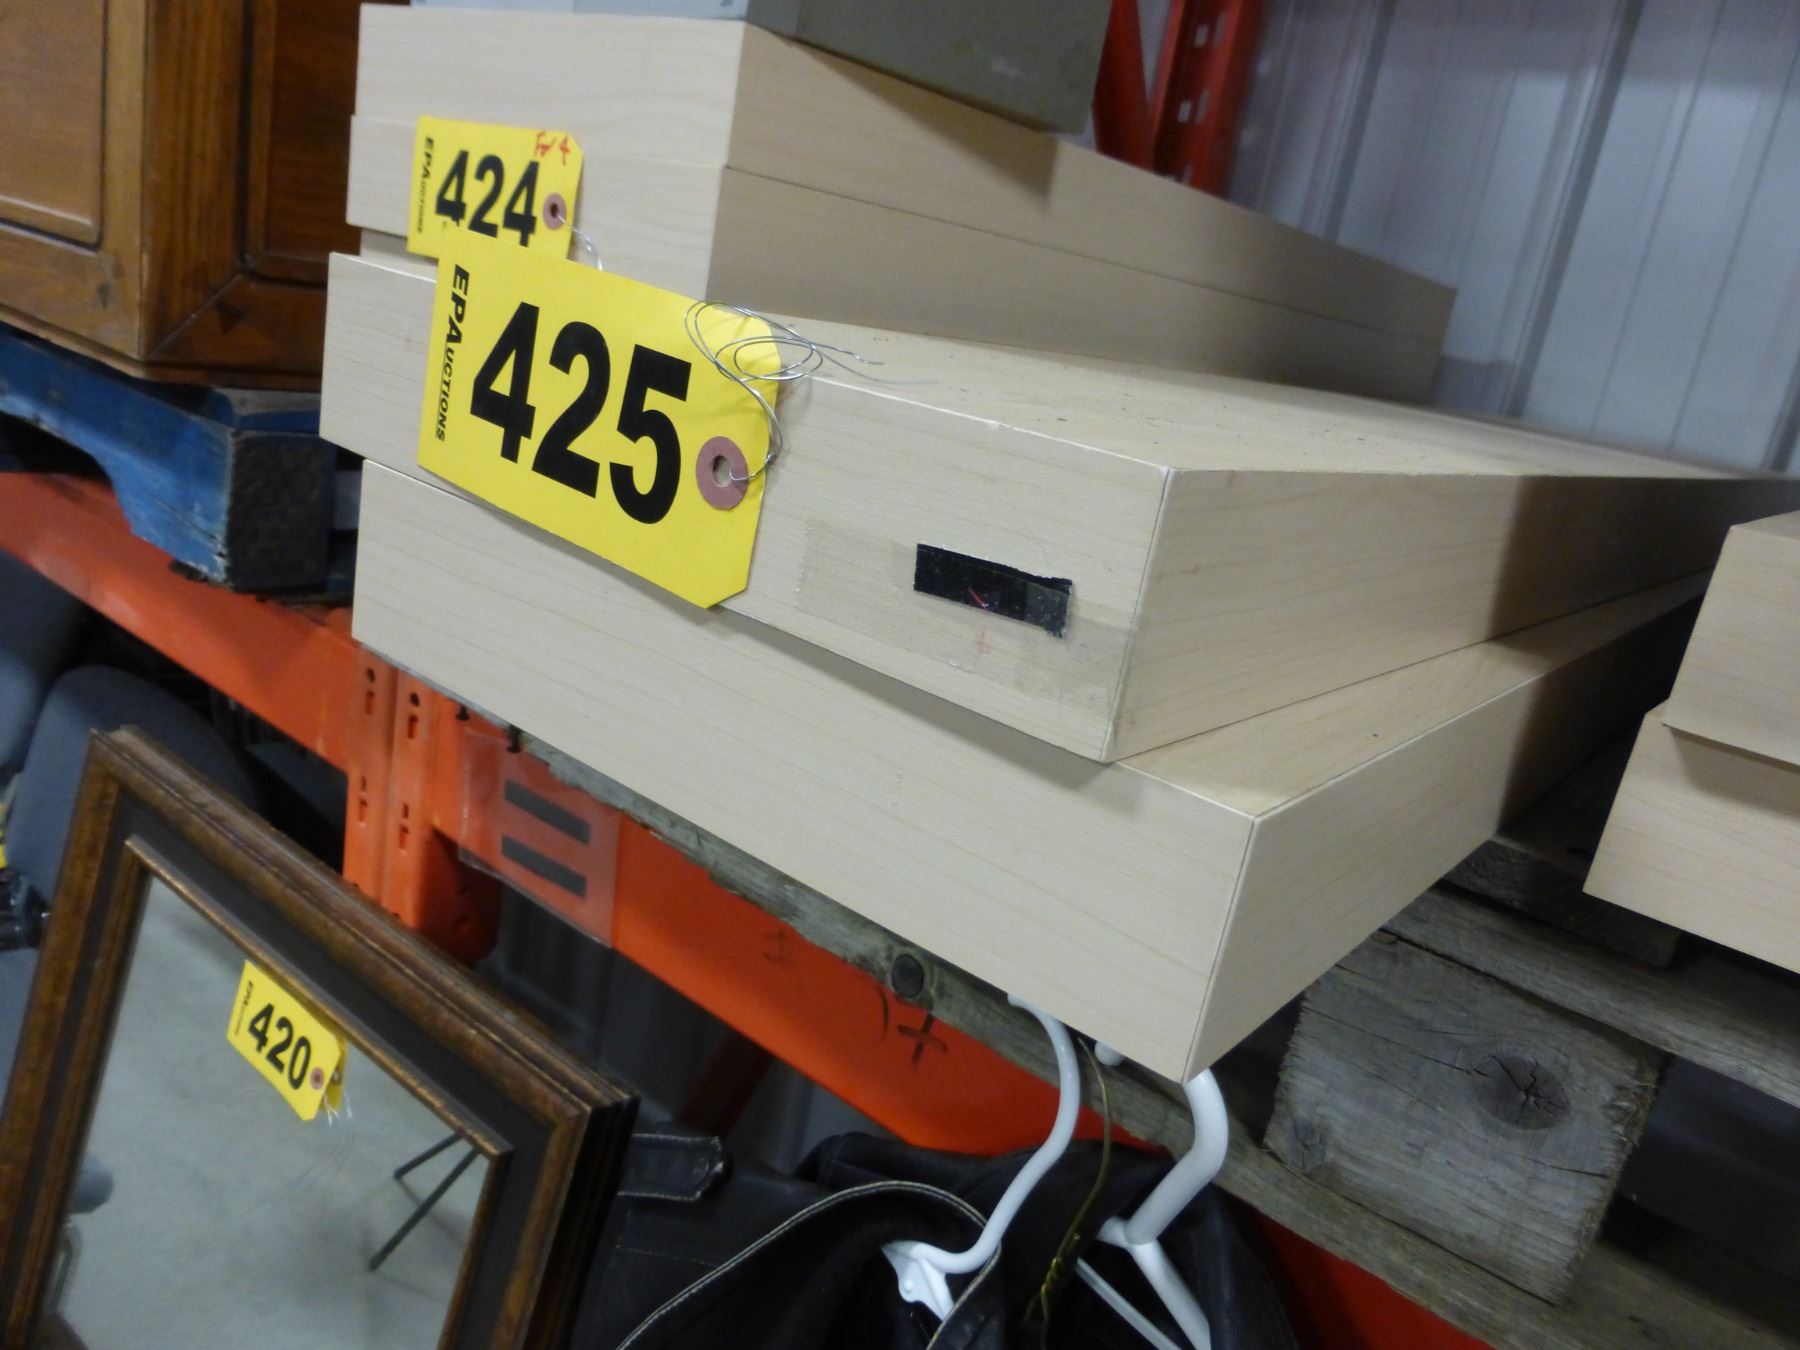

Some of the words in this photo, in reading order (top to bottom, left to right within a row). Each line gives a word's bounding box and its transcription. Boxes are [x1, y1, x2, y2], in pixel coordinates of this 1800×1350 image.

[435, 149, 540, 248] 424
[469, 301, 692, 525] 425
[247, 1002, 312, 1091] 420
